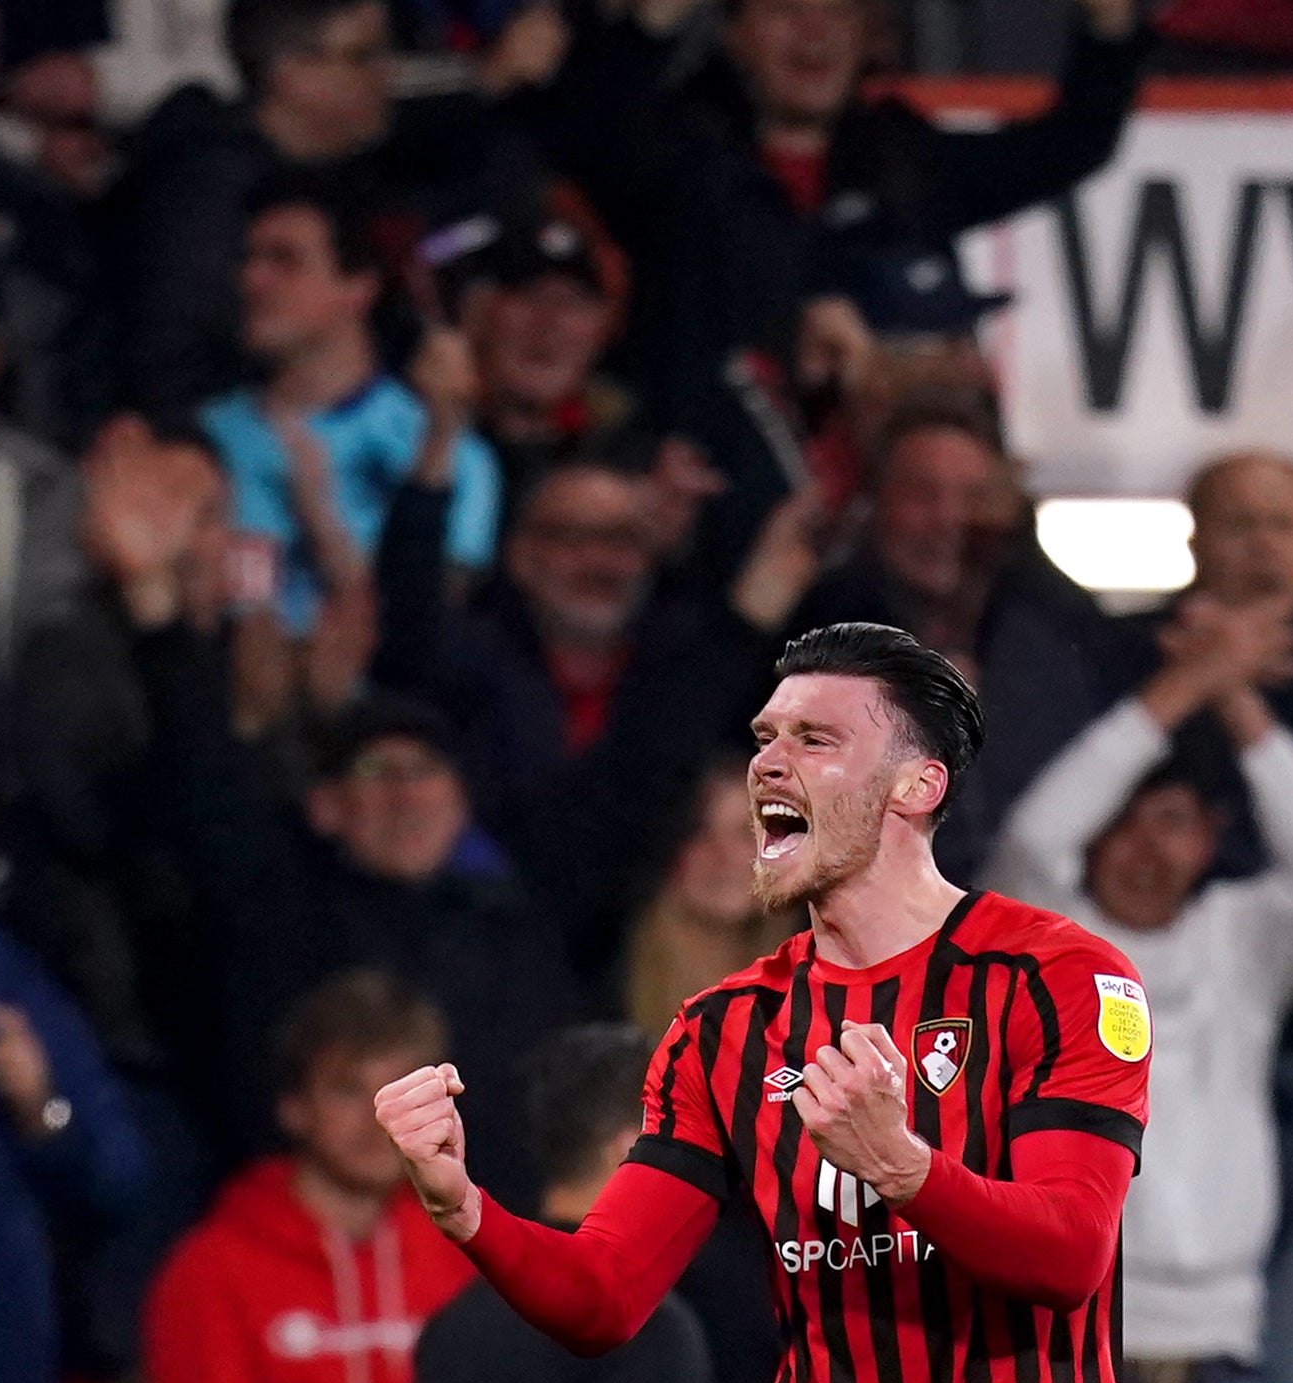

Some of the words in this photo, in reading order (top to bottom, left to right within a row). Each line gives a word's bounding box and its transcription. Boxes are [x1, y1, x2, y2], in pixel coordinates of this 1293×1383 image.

[1101, 980, 1121, 994] sky
[767, 1090, 793, 1103] umbr
[775, 1231, 935, 1273] SPCAPIT
